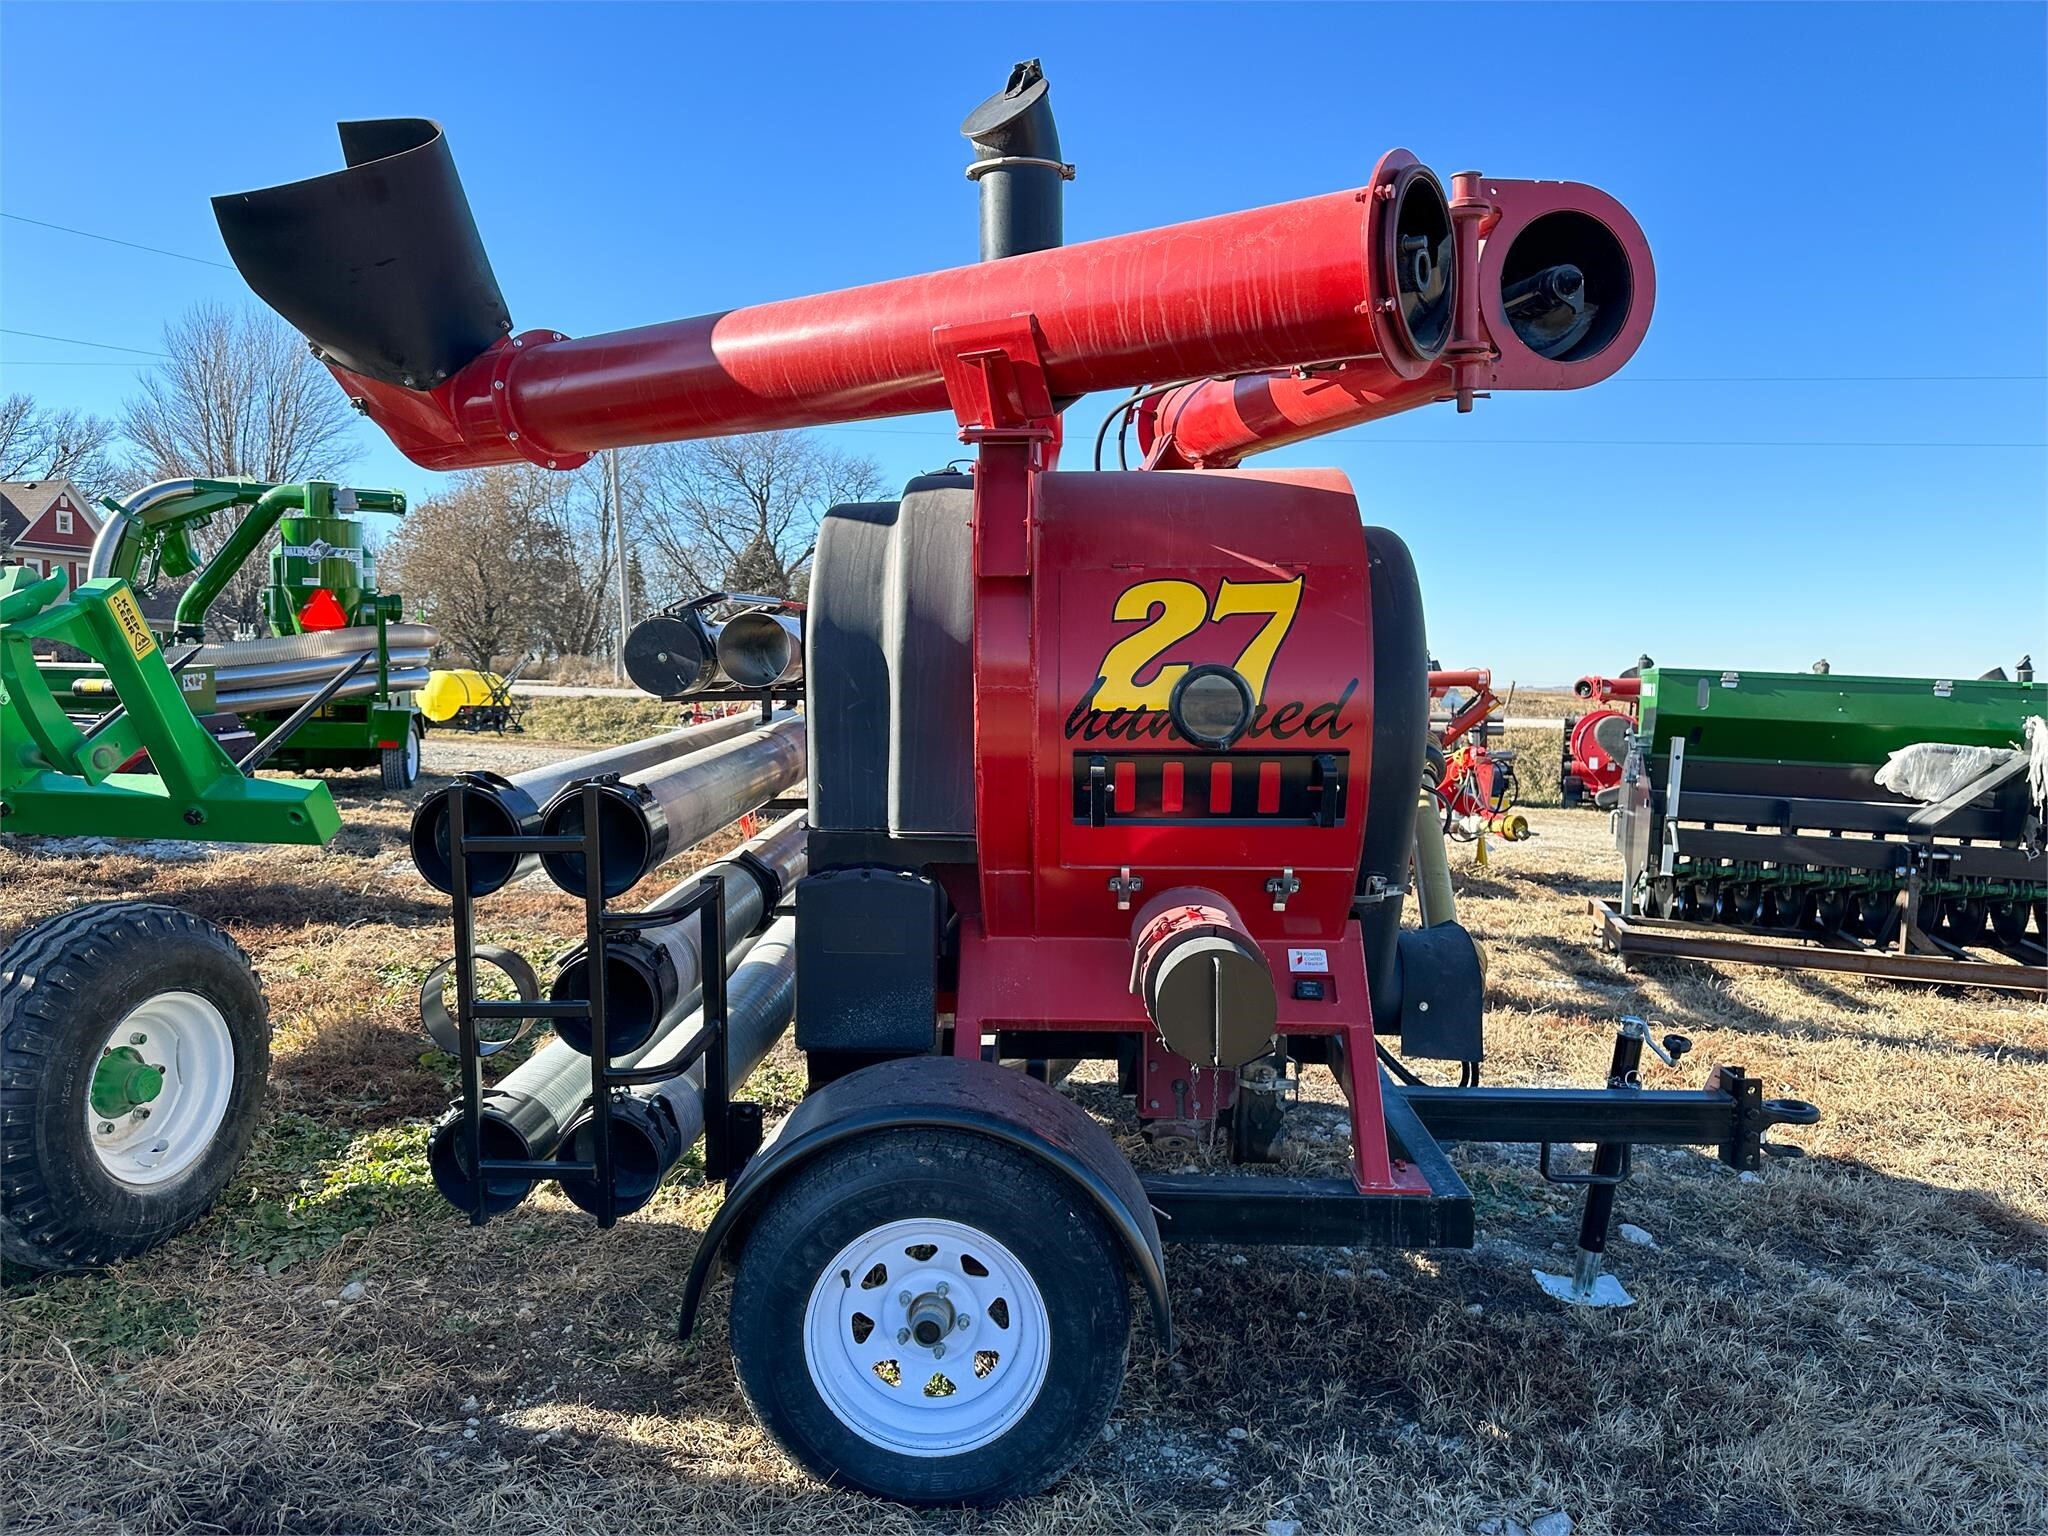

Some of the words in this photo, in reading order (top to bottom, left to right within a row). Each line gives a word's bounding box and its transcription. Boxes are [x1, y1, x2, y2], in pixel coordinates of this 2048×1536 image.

[113, 596, 135, 635] CLEAR
[121, 598, 140, 630] KEEP
[1090, 573, 1305, 712] 27
[1064, 676, 1359, 741] hunred
